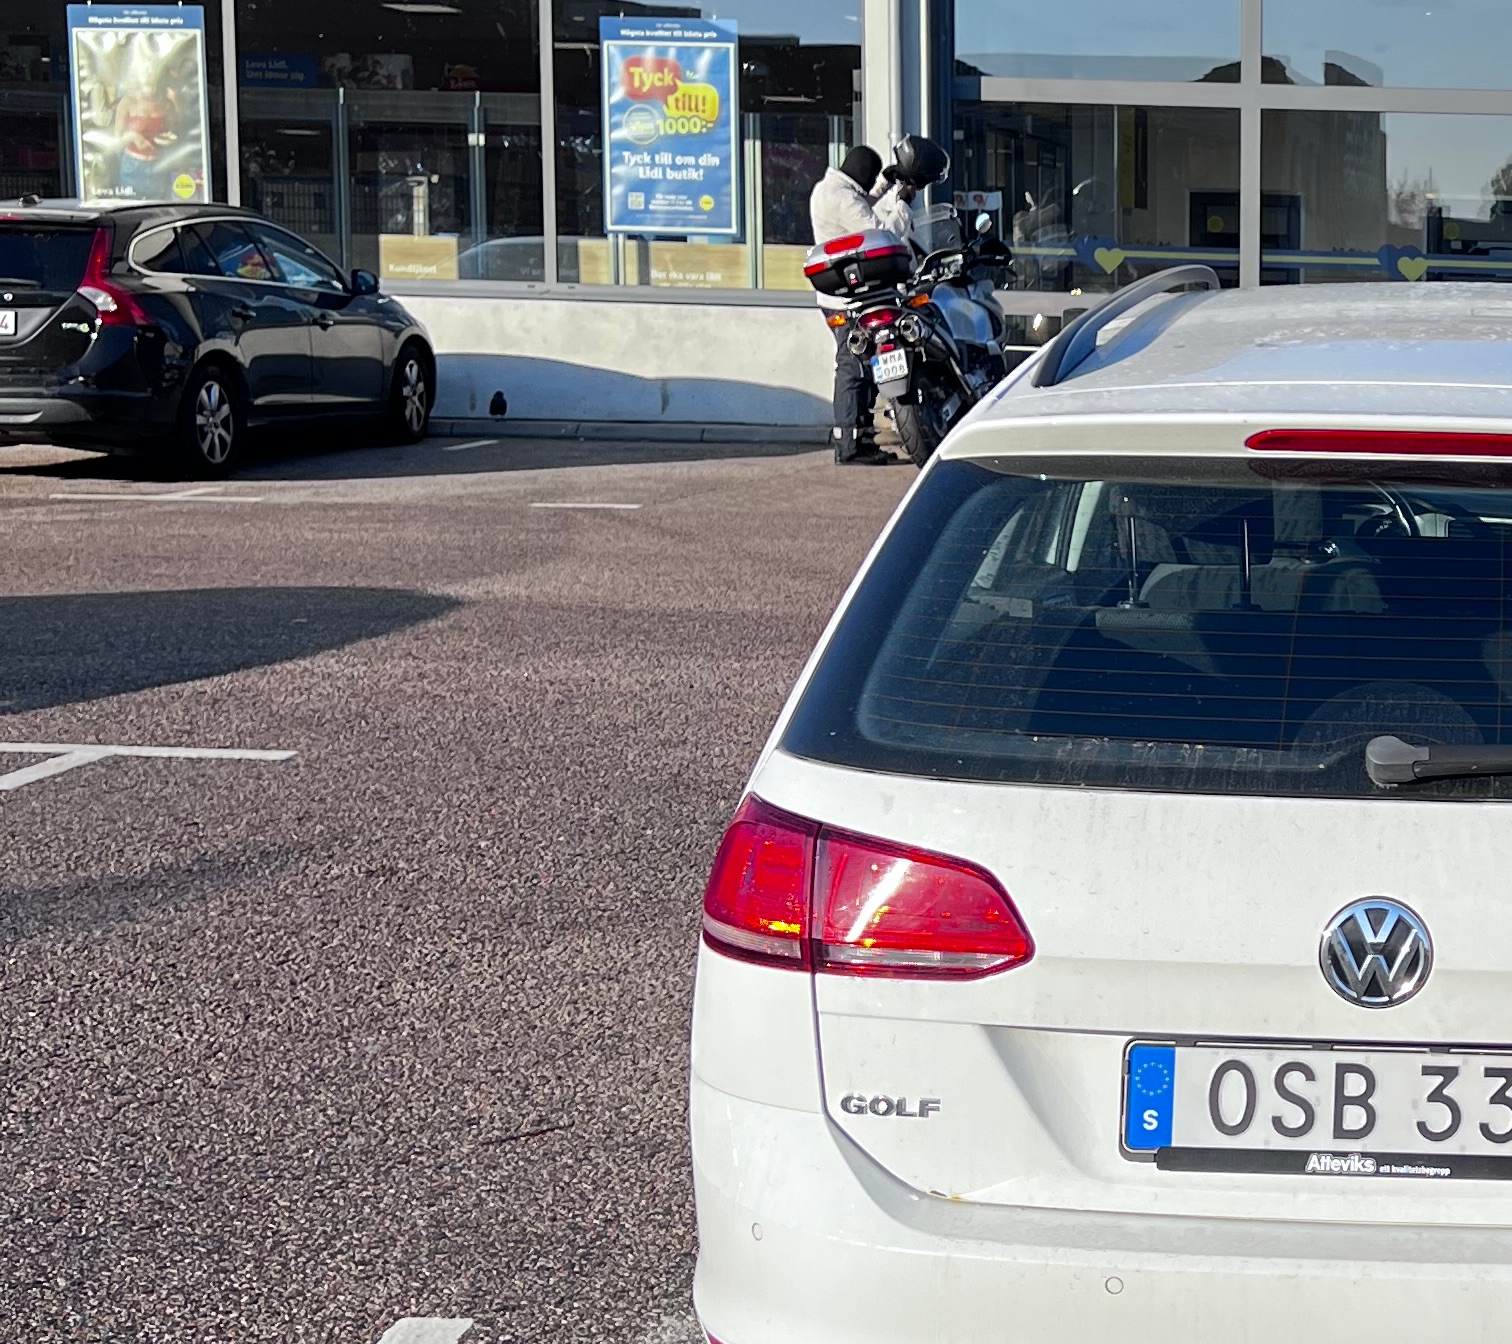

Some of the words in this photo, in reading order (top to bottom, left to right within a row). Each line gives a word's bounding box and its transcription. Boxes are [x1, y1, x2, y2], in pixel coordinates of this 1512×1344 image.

[629, 66, 674, 93] Tyck
[674, 93, 707, 114] till!
[655, 116, 714, 135] 1000:-
[621, 150, 652, 167] Tyck
[654, 152, 673, 166] till
[675, 155, 696, 166] om
[697, 153, 720, 167] din
[638, 166, 663, 180] Lidl
[665, 168, 704, 181] butik!
[840, 1093, 941, 1117] GOLF
[1208, 1058, 1377, 1141] OSB
[1142, 1109, 1159, 1131] S
[1306, 1154, 1376, 1173] Atteviks
